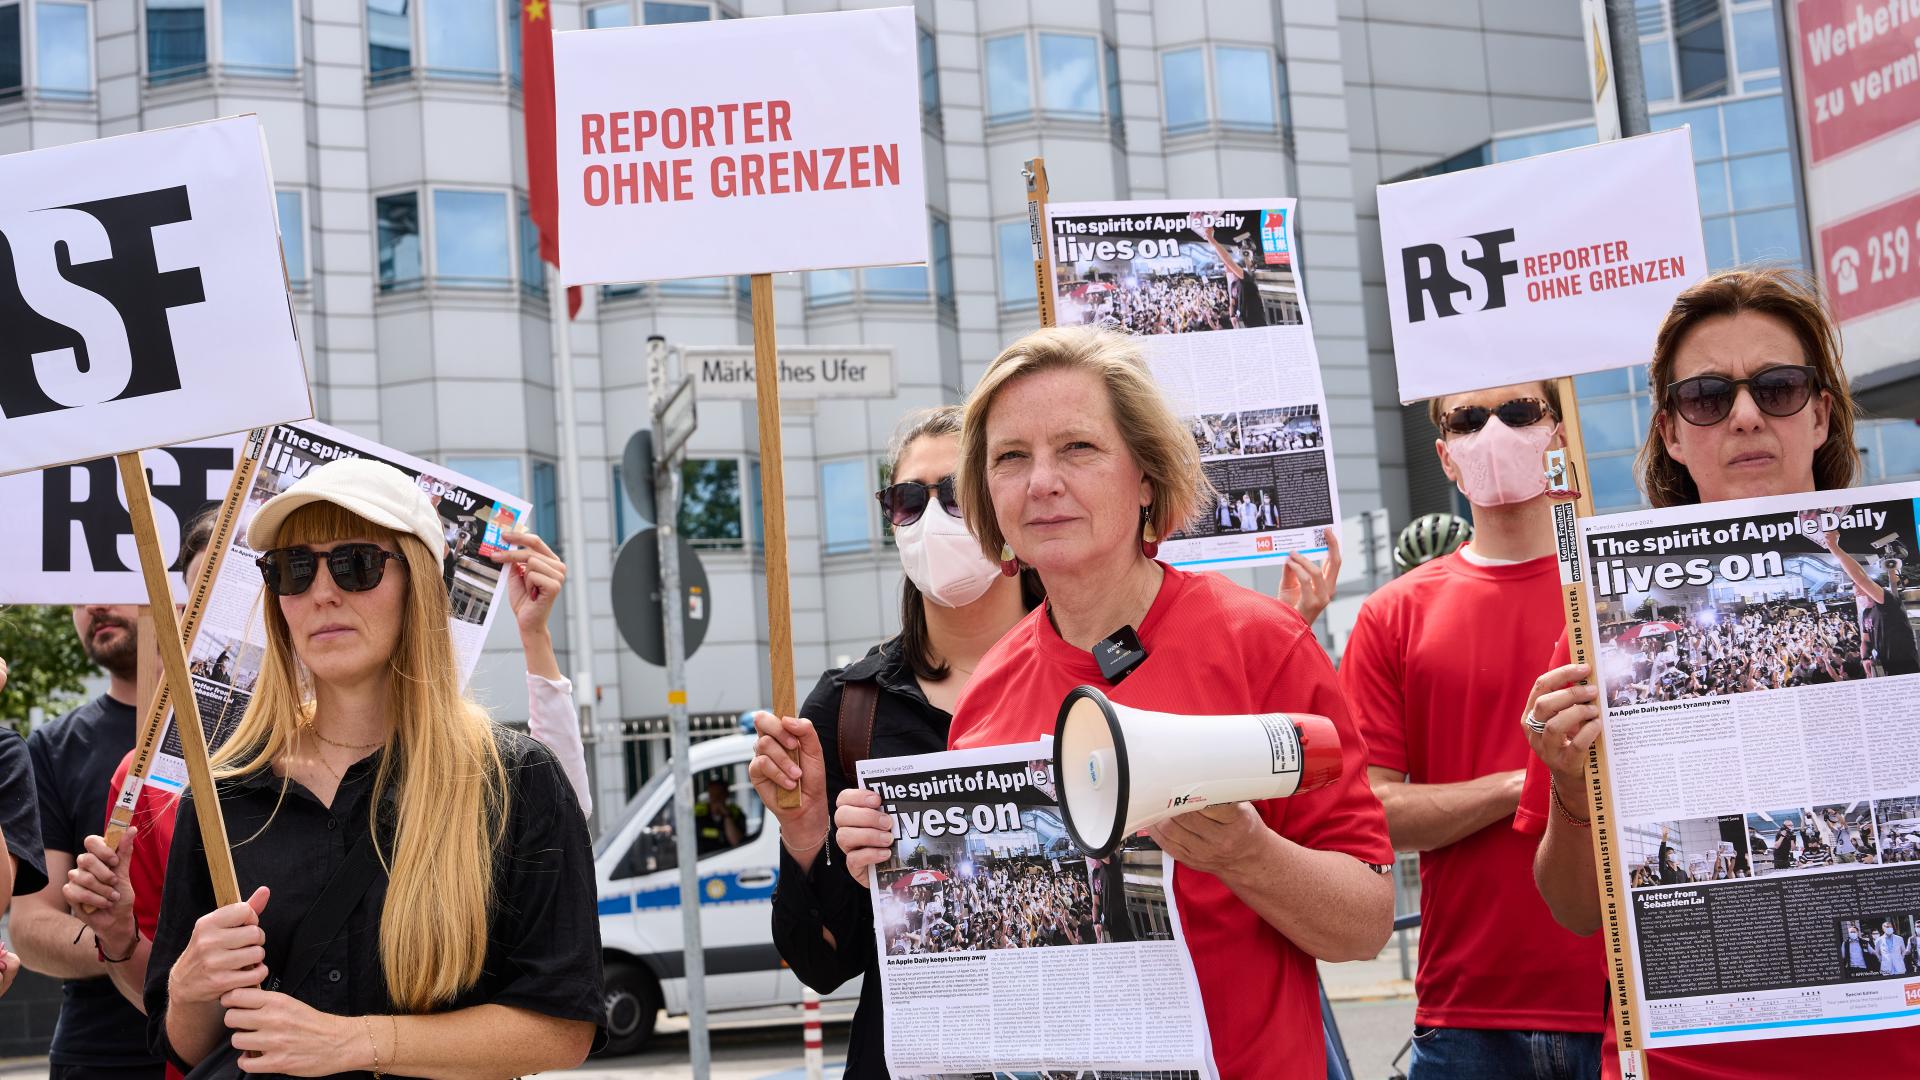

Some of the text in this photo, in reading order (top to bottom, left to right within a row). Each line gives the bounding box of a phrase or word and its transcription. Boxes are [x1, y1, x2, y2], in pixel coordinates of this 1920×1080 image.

[1814, 85, 1844, 124] zu
[581, 100, 792, 155] REPORTER
[583, 143, 900, 207] OHNE GRENZEN
[1055, 213, 1245, 237] The spirit of Apple Daily
[1057, 236, 1181, 264] lives on
[1523, 239, 1630, 278] REPORTER
[1867, 224, 1910, 284] 259
[1401, 227, 1519, 324] RSF
[1527, 255, 1686, 303] OHNE GRENZEN
[702, 358, 867, 383] Märkhes Ufer
[278, 425, 311, 450] The
[241, 457, 252, 475] FOLT
[266, 442, 314, 479] liv
[236, 476, 247, 491] UND
[431, 481, 476, 511] Daily
[1256, 540, 1270, 549] 140
[1555, 505, 1569, 561] Keine Freiheit
[1565, 504, 1580, 580] ohne Pressefreiheit
[1592, 507, 1887, 557] The spirit of Apple Daily
[203, 550, 219, 584] LÄNDERN
[1598, 549, 1786, 597] lives on
[193, 582, 207, 610] VIELEN
[1570, 587, 1580, 623] FOLTER.
[191, 609, 199, 620] IN
[1573, 627, 1583, 646] UND
[194, 687, 223, 701] ebastien
[1619, 708, 1640, 716] Apple
[1641, 704, 1659, 713] Daily
[1660, 702, 1682, 711] keeps
[1683, 700, 1711, 709] tyranny
[1713, 698, 1731, 706] away
[134, 763, 144, 778] FÜR
[139, 747, 149, 762] DIE
[144, 712, 162, 748] WAHRHEIT
[869, 781, 907, 800] The
[909, 774, 963, 801] spirit
[964, 771, 984, 792] of
[986, 766, 1047, 794] Apple
[888, 802, 1023, 841] ives on
[1588, 740, 1615, 899] JOURNALISTEN IN VIELEN LÄNDE
[1637, 889, 1698, 902] A letter from
[1643, 896, 1705, 909] Sebastien Lai
[1610, 902, 1622, 953] RISKIEREN
[896, 957, 913, 965] Apple
[930, 955, 948, 964] keeps
[1615, 957, 1628, 1006] WAHRHEIT
[1621, 1009, 1630, 1026] DIE
[1625, 1031, 1633, 1048] FÜR
